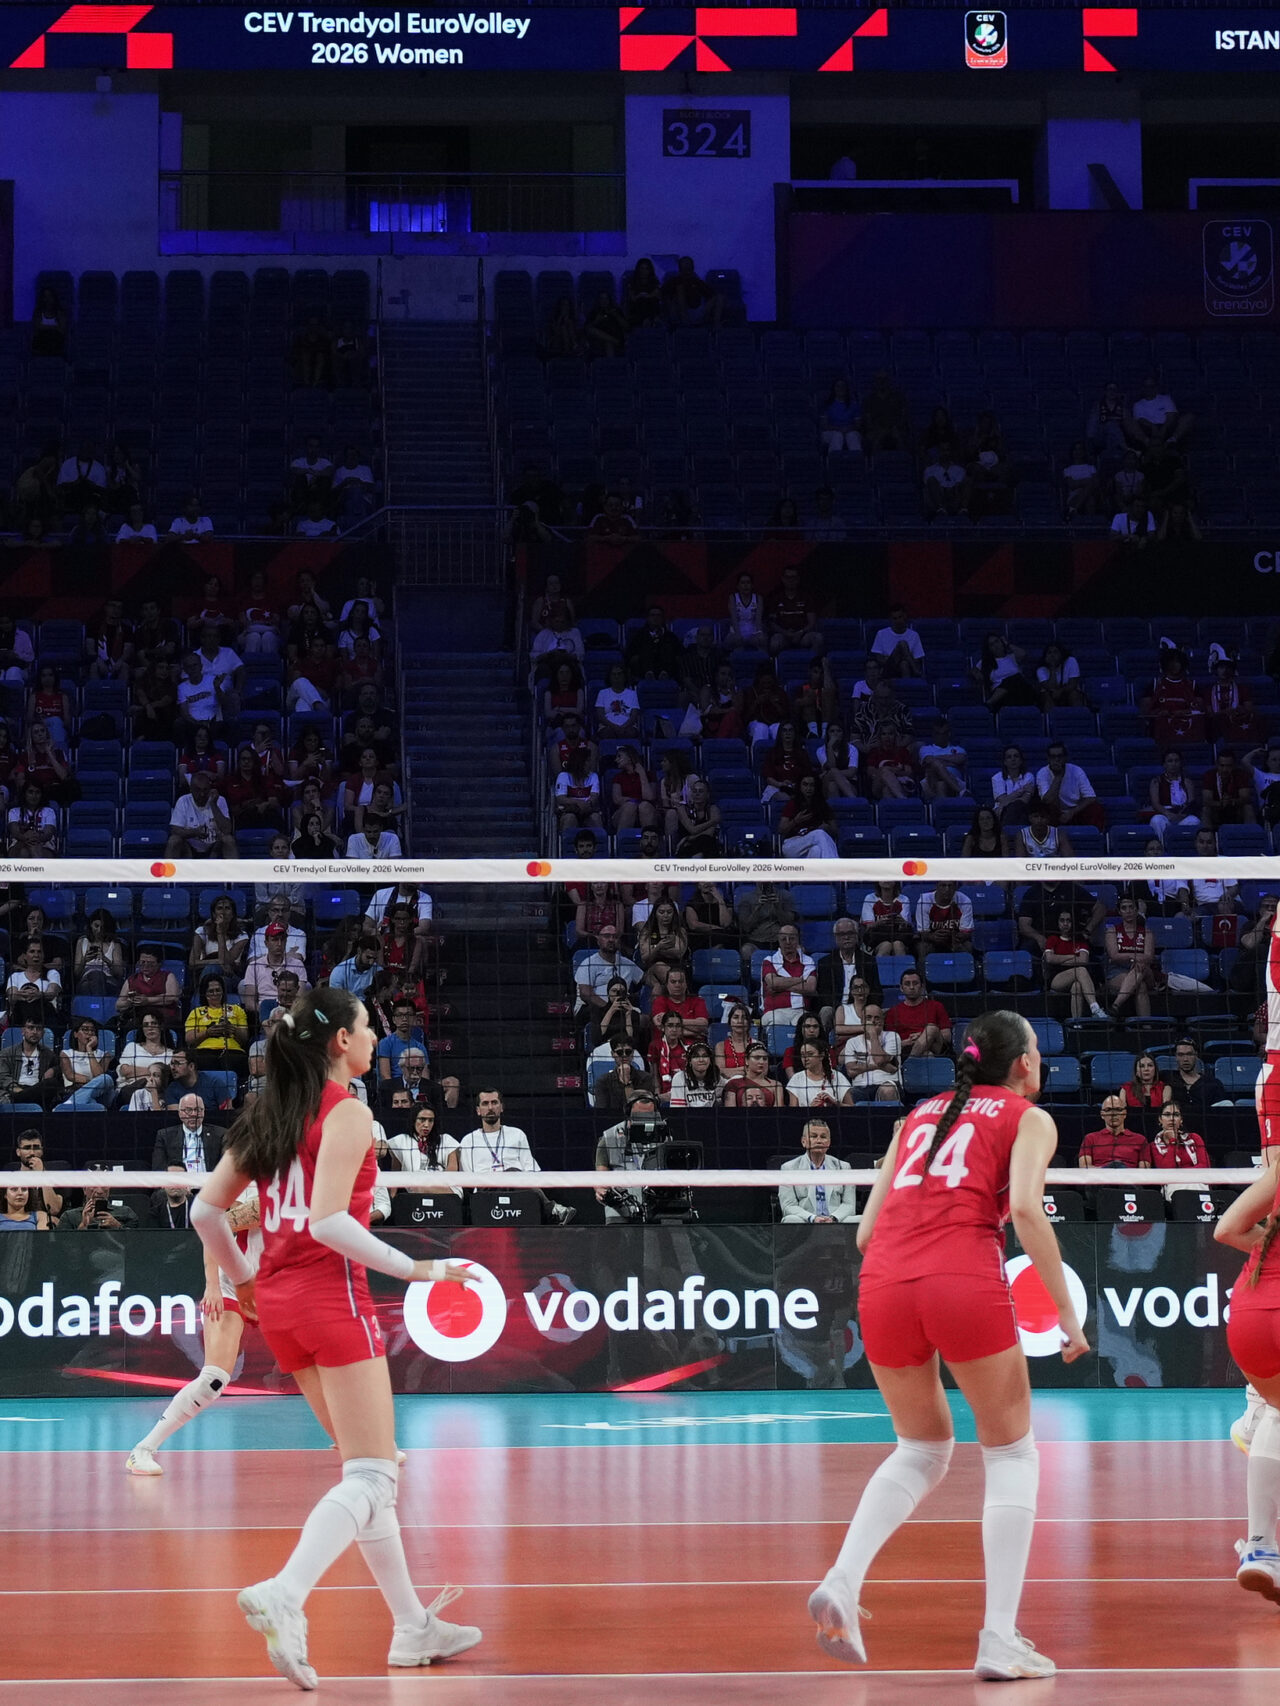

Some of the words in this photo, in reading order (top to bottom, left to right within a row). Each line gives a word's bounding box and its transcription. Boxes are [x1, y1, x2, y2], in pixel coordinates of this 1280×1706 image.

[976, 14, 995, 22] CEV
[244, 12, 294, 33] CEV
[298, 12, 400, 38] Trendyol
[407, 12, 531, 39] EuroVolley
[311, 43, 369, 64] 2026
[374, 43, 464, 64] Women
[667, 121, 747, 156] 324
[1222, 226, 1252, 237] CEV
[1213, 299, 1267, 312] trendyol
[13, 864, 45, 873] Women
[273, 864, 291, 873] CEV
[292, 864, 327, 874] Trendyol
[328, 864, 371, 875] EuroVolley
[372, 864, 392, 873] 2026
[393, 865, 425, 873] Women
[654, 864, 671, 873] CEV
[672, 864, 707, 874] Trendyol
[708, 864, 751, 874] EuroVolley
[752, 864, 772, 873] 2026
[774, 864, 805, 873] Women
[1025, 863, 1042, 872] CEV
[1043, 863, 1079, 872] Trendyol
[1080, 862, 1122, 872] EuroVolley
[1123, 862, 1143, 871] 2026
[1144, 862, 1176, 871] Women
[1265, 1118, 1272, 1139] 3
[893, 1122, 976, 1190] 24
[264, 1154, 311, 1233] 34
[425, 1210, 444, 1219] TVF
[504, 1209, 522, 1218] TVF
[523, 1275, 820, 1332] vodafone
